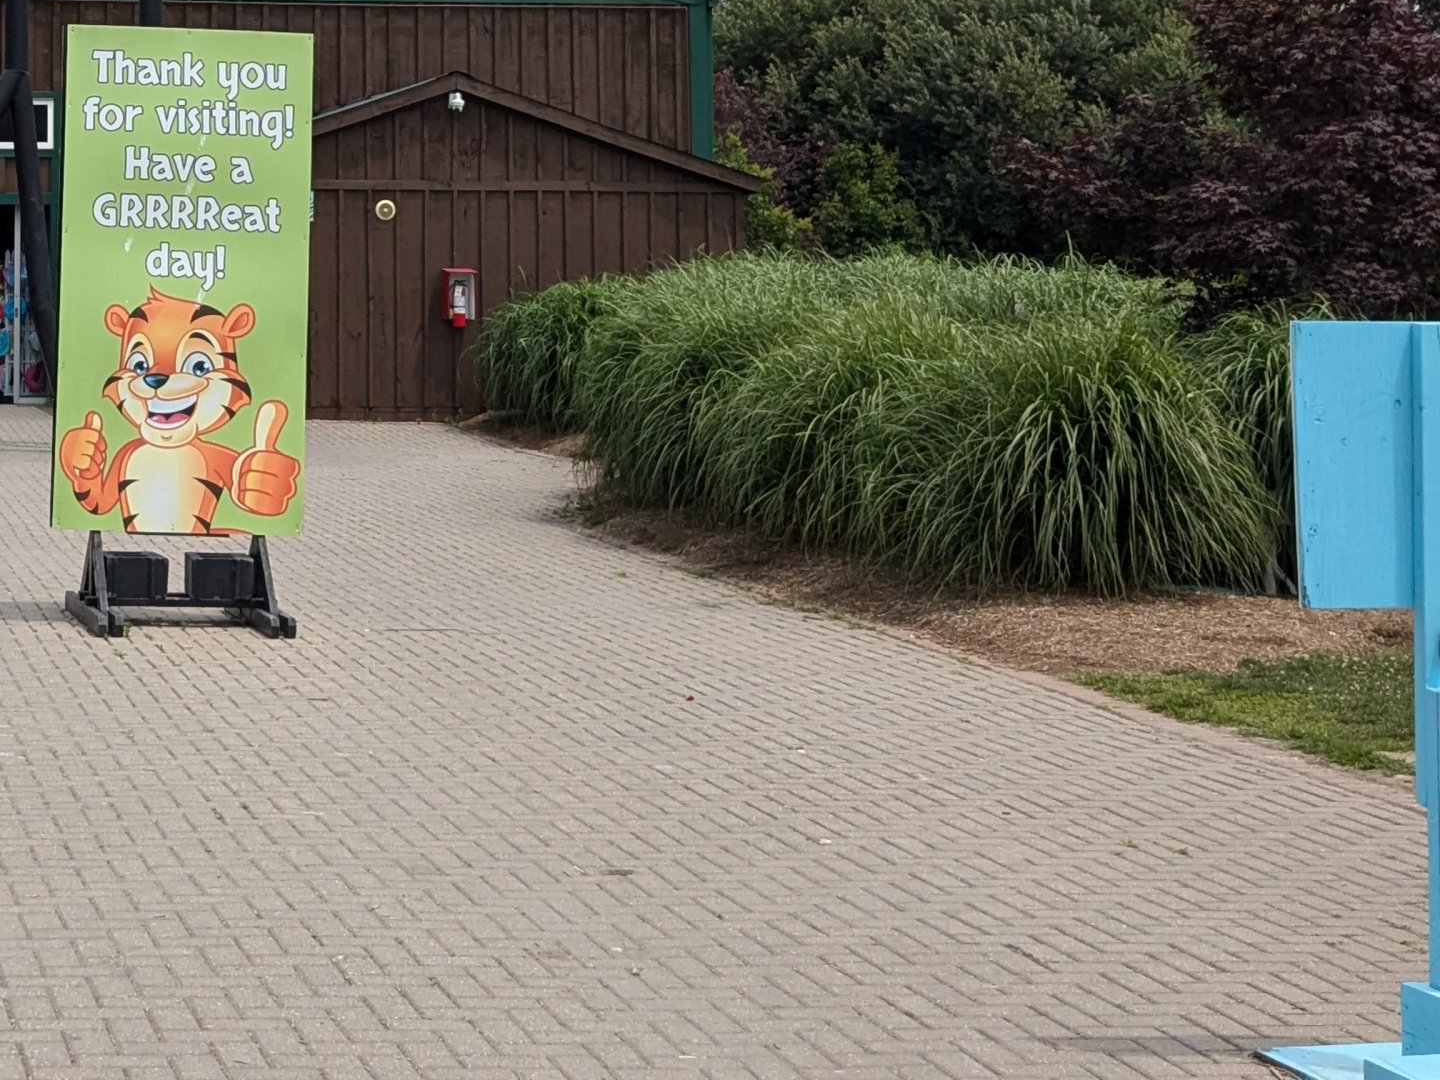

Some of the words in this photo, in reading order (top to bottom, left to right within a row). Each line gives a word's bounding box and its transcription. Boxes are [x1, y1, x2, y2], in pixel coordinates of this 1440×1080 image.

[91, 48, 206, 87] Thank
[216, 61, 288, 101] you
[82, 96, 144, 132] for
[155, 99, 295, 150] visiting!
[123, 145, 217, 183] Have
[229, 155, 254, 184] a
[92, 192, 282, 234] GRRRReat
[144, 242, 227, 291] day!
